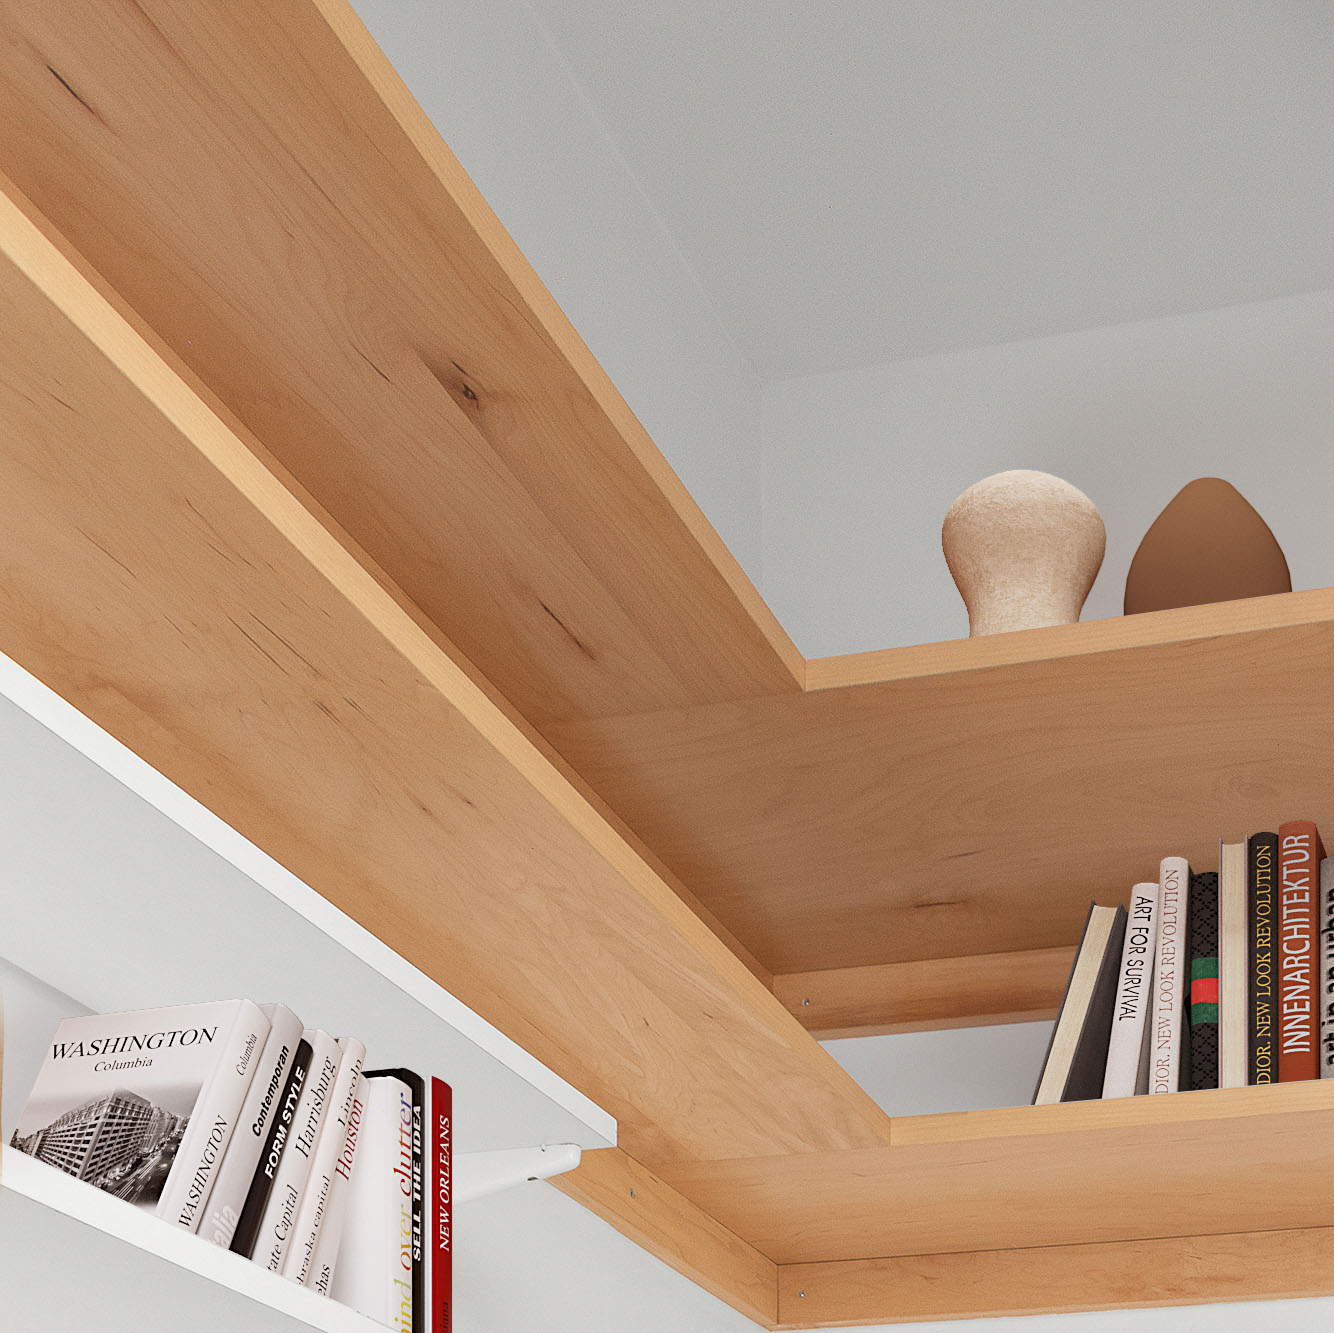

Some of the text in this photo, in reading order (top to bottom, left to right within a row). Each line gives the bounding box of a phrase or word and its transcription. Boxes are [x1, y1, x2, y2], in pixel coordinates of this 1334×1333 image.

[1118, 896, 1154, 1021] ART FOR SURVIVAL
[1155, 869, 1179, 1094] DIOR. NEW LOOK REVOLUTION
[1256, 845, 1271, 1085] DIOR. NEW LOOK REVOLUTION
[1282, 834, 1311, 1054] INNENARCHITEKTUR
[52, 1026, 219, 1060] WASHINGTON
[94, 1057, 153, 1072] Columbia
[236, 1033, 258, 1076] Columbia
[337, 1059, 362, 1127] Lincoln
[264, 1066, 306, 1180] FORM STYLE
[295, 1056, 337, 1159] Harrisburg
[335, 1099, 363, 1181] Houston
[393, 1092, 411, 1197] clutter
[178, 1114, 229, 1227] WASHINGTON
[412, 1105, 422, 1262] SELL THE IDEA
[439, 1114, 450, 1252] NEW ORLEANS
[210, 1205, 240, 1247] alia
[267, 1183, 299, 1272] tate Capital
[297, 1175, 331, 1284] braska capital
[400, 1203, 412, 1271] over
[315, 1264, 332, 1296] ehas
